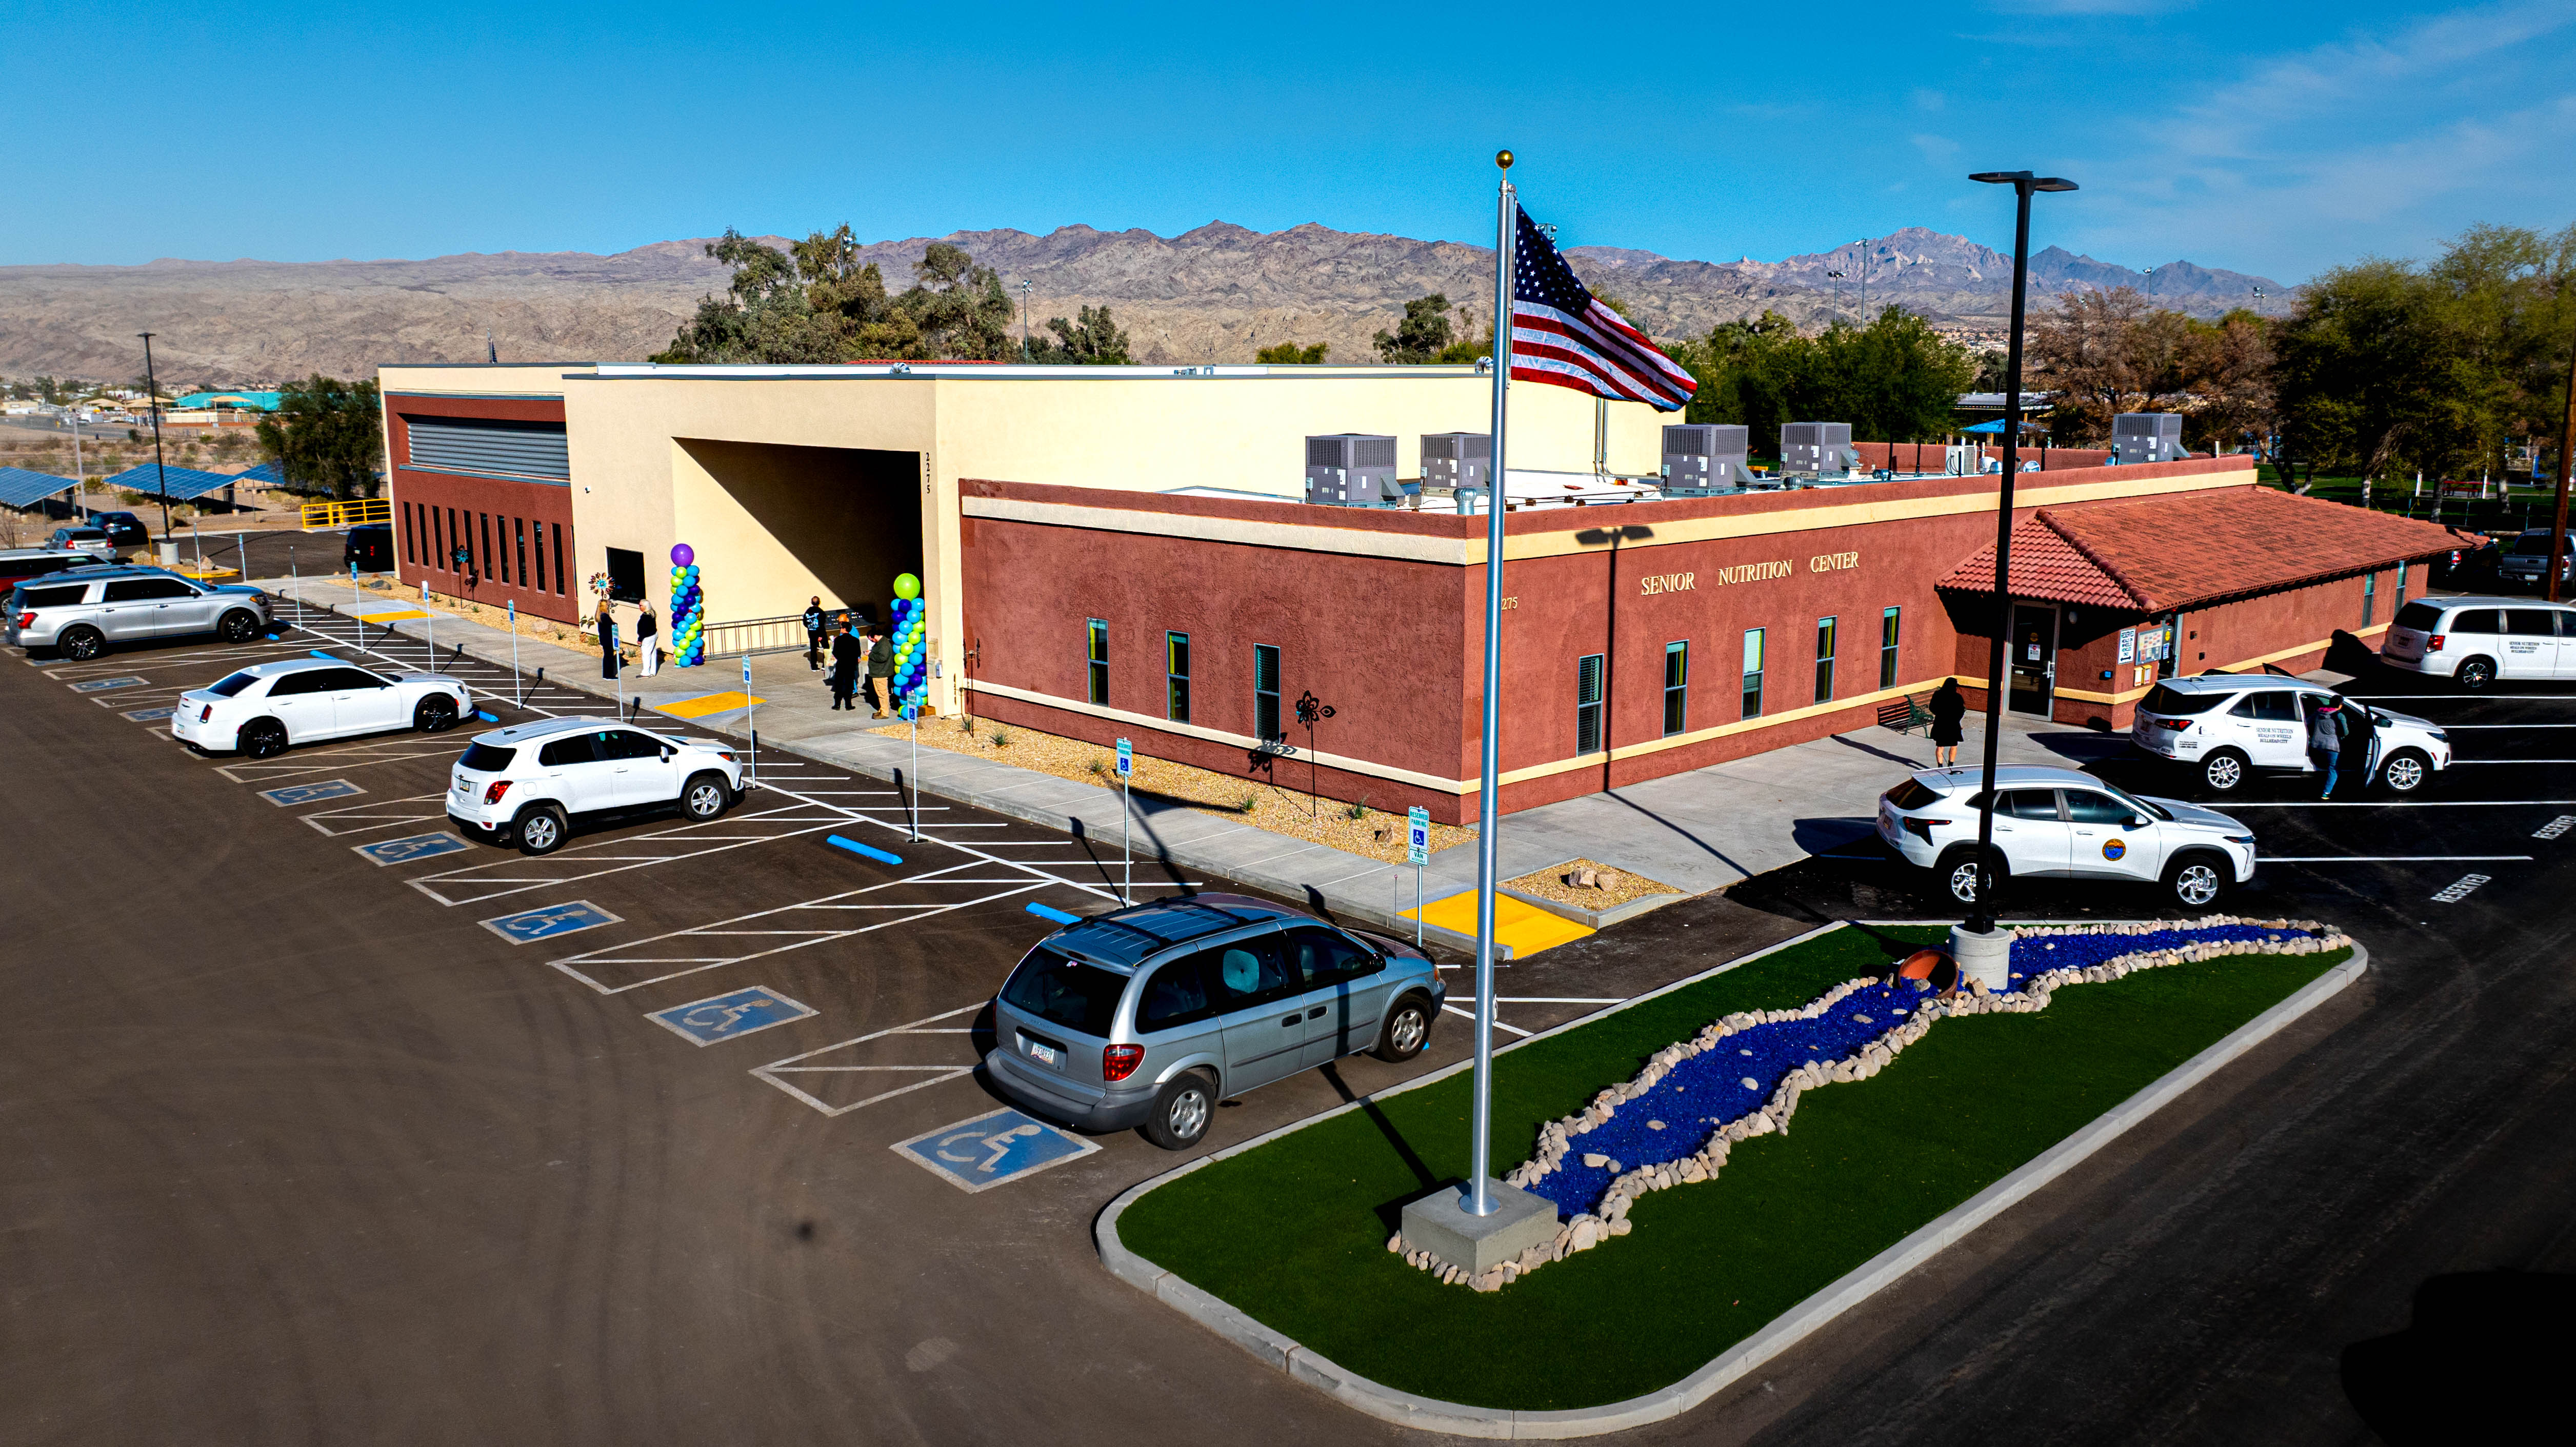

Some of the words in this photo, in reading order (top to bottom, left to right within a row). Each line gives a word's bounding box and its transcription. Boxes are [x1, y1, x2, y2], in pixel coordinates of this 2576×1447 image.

[1641, 572, 1696, 596] SENIOR
[1718, 559, 1792, 586] NUTRITION
[1810, 551, 1859, 573] CENTER
[1117, 742, 1131, 750] RESERVED
[1410, 811, 1428, 820] RESERVED
[1411, 818, 1427, 828] PARKING
[2531, 815, 2576, 840] RESERVED
[2430, 873, 2492, 903] RESERVED
